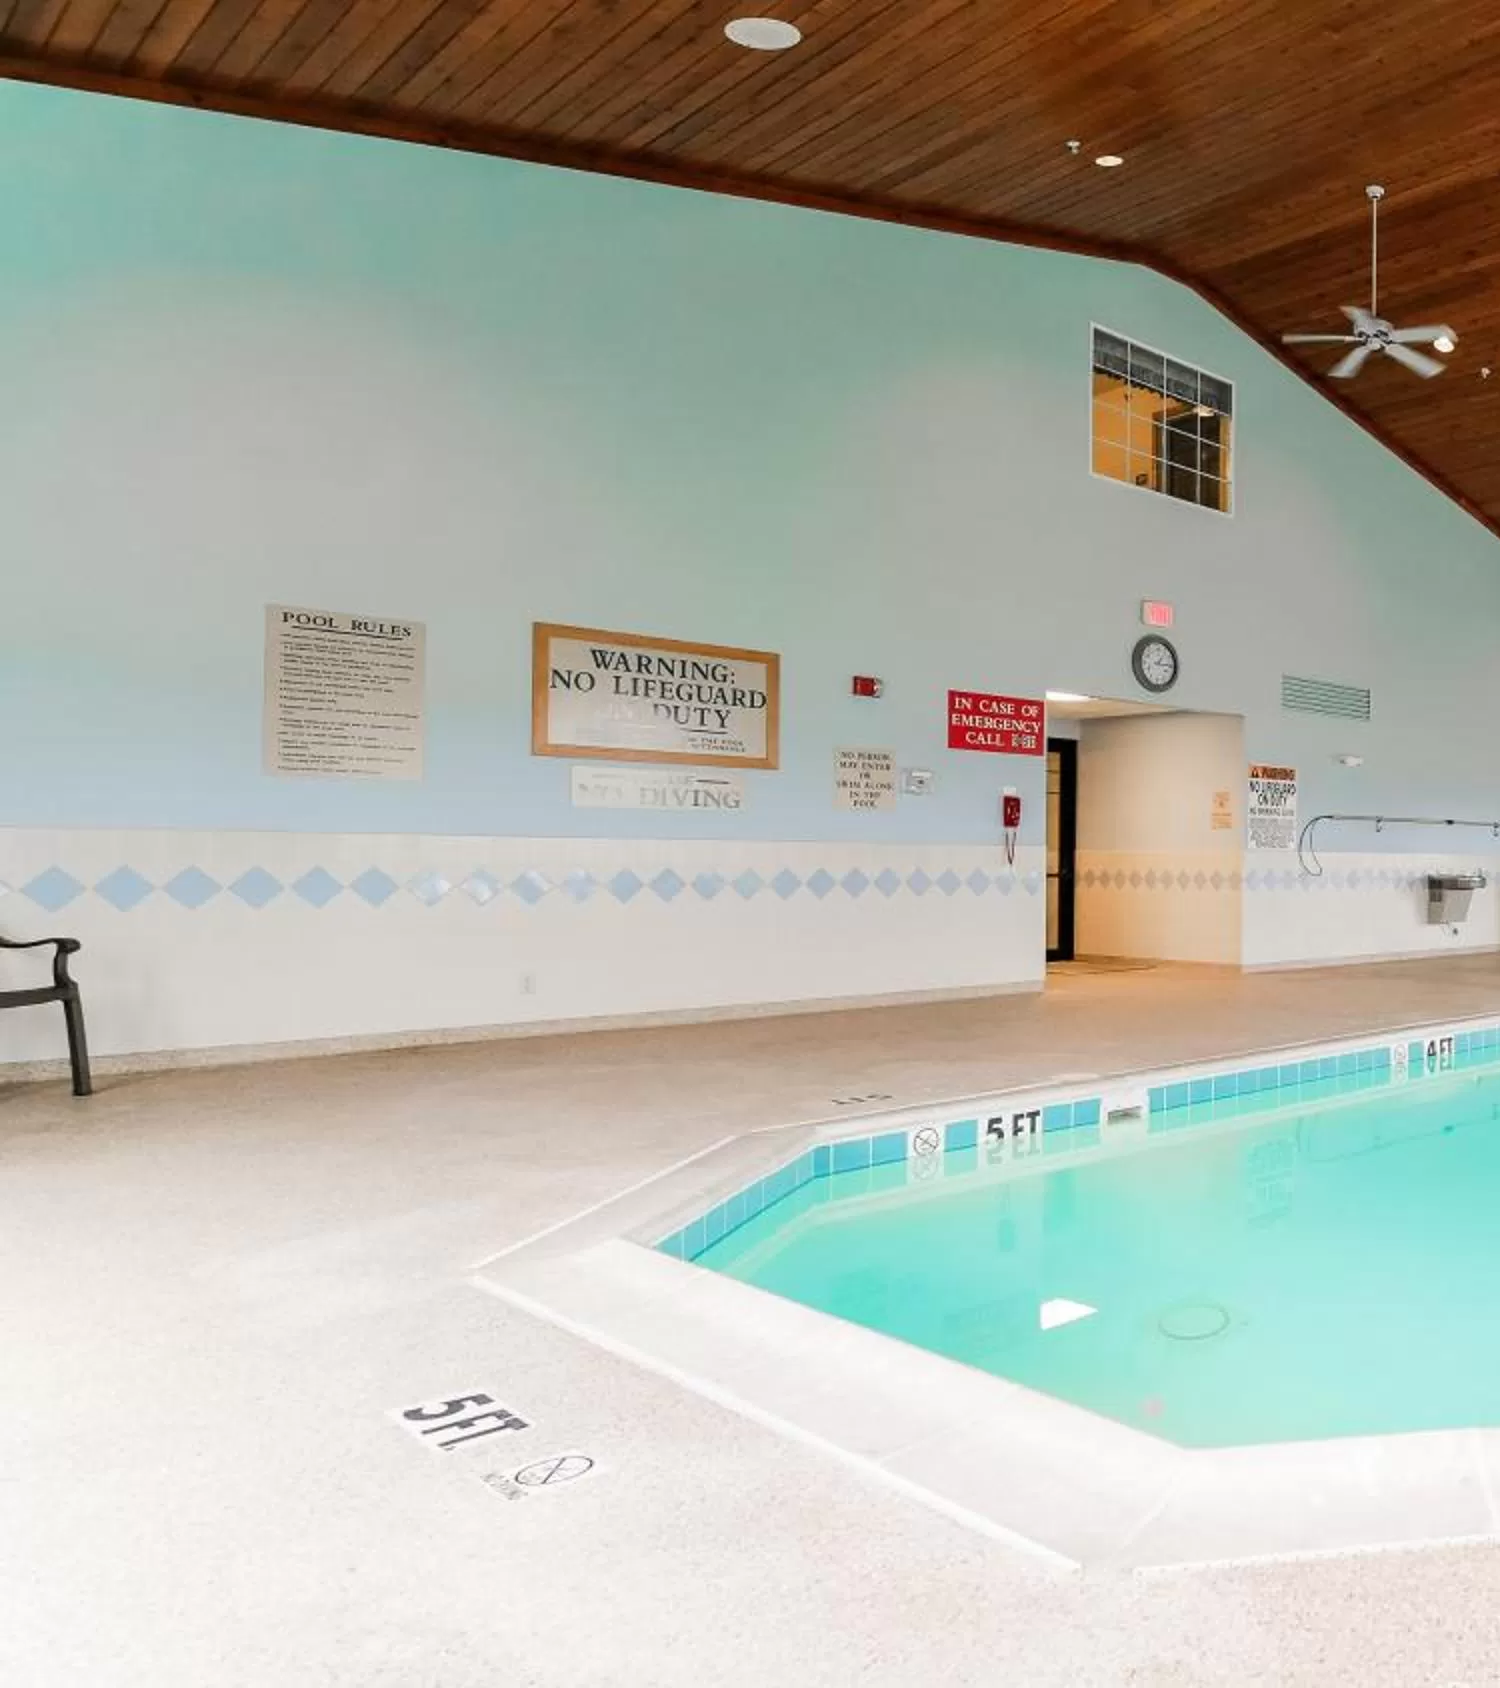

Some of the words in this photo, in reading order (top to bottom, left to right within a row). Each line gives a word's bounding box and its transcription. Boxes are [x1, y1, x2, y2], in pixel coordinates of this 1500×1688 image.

[281, 611, 340, 629] POOL
[351, 619, 411, 637] RULES
[590, 649, 735, 685] WARNING:
[550, 669, 595, 693] NO
[613, 675, 768, 709] LIFEGUARD
[653, 703, 731, 729] DUTY
[955, 697, 973, 710] IN
[979, 699, 1015, 715] CASE
[1021, 705, 1039, 717] OF
[951, 713, 1040, 733] EMERGENCY
[965, 731, 1005, 746] CALL
[640, 786, 740, 809] DIVING
[1427, 1040, 1437, 1056] 4
[986, 1116, 1004, 1139] 5
[1012, 1110, 1040, 1136] FT
